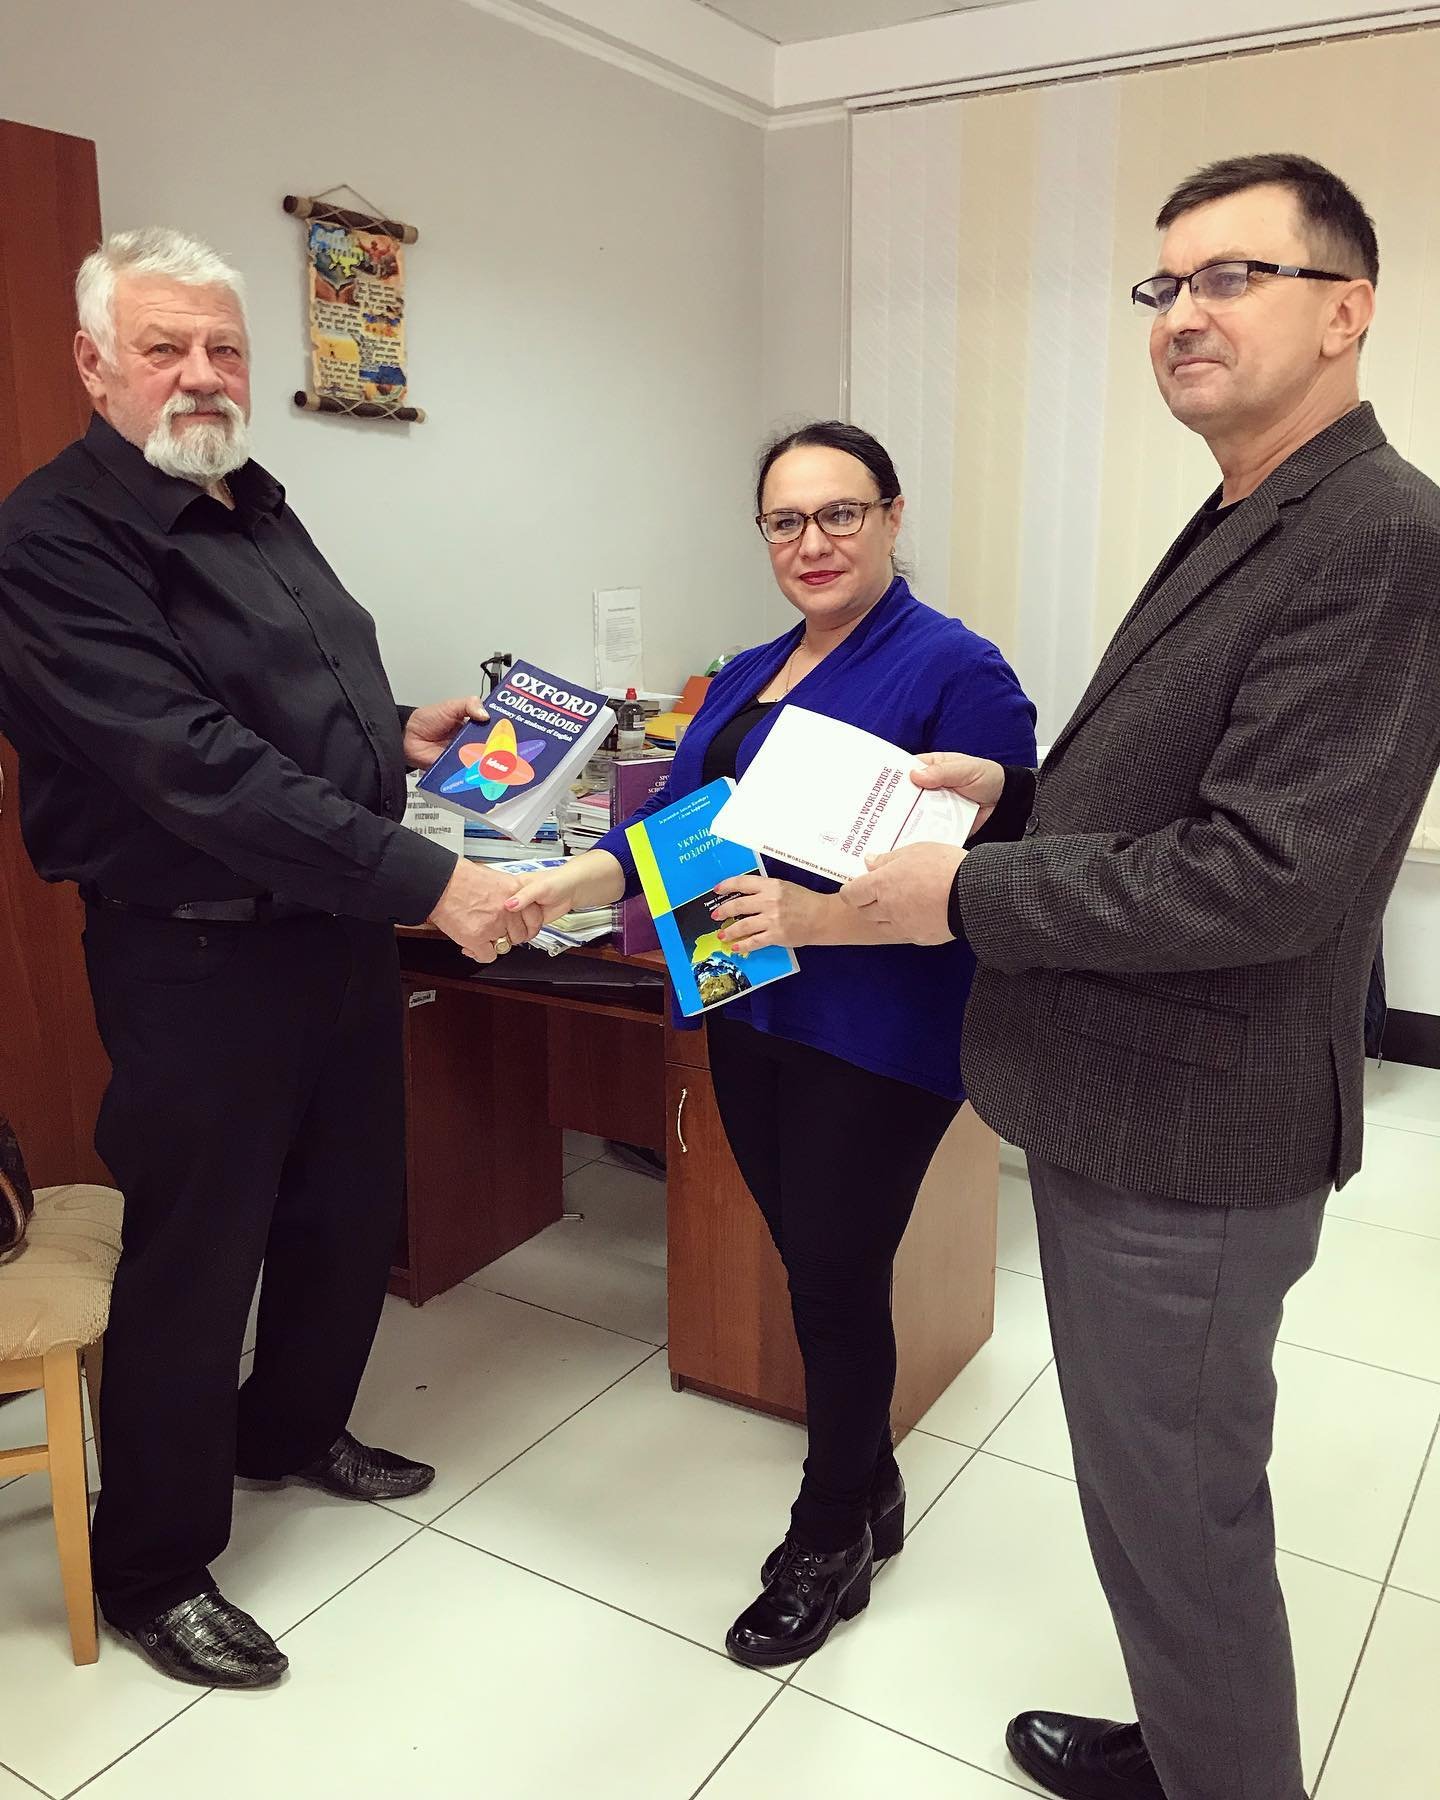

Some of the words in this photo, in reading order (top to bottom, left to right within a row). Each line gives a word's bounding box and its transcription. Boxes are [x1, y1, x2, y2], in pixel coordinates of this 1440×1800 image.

[496, 690, 583, 734] Collocations
[510, 672, 598, 717] OXFORD
[488, 702, 516, 718] dictionary
[514, 713, 526, 722] for
[523, 718, 547, 732] students
[546, 725, 556, 735] of
[552, 730, 574, 743] English
[840, 815, 866, 854] 2000-2001
[859, 765, 893, 816] WORLDWIDE
[851, 811, 881, 858] ROTARACT
[875, 768, 904, 813] DIRECTORY
[677, 828, 712, 851] УКРАЇН
[679, 837, 724, 864] РОЗДОРІЖ
[786, 853, 819, 869] WORLDWIDE
